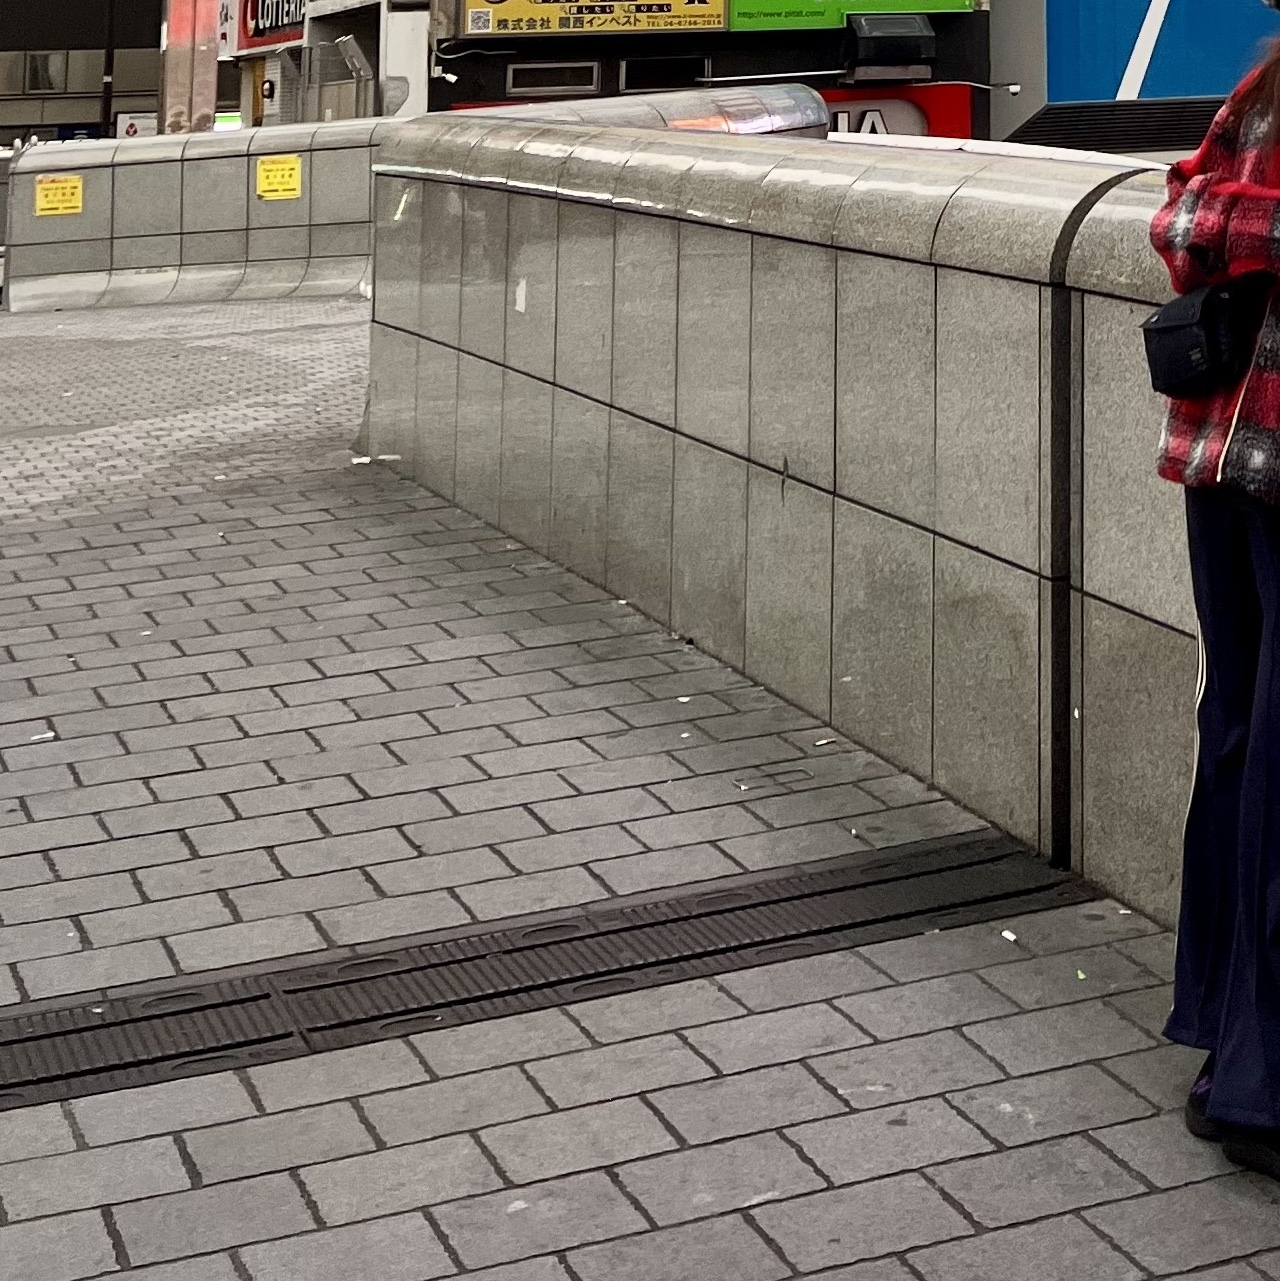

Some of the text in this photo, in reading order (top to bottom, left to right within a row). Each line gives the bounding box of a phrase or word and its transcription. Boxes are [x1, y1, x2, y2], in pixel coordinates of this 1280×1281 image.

[496, 15, 642, 30] 株式会社 関西インベスト
